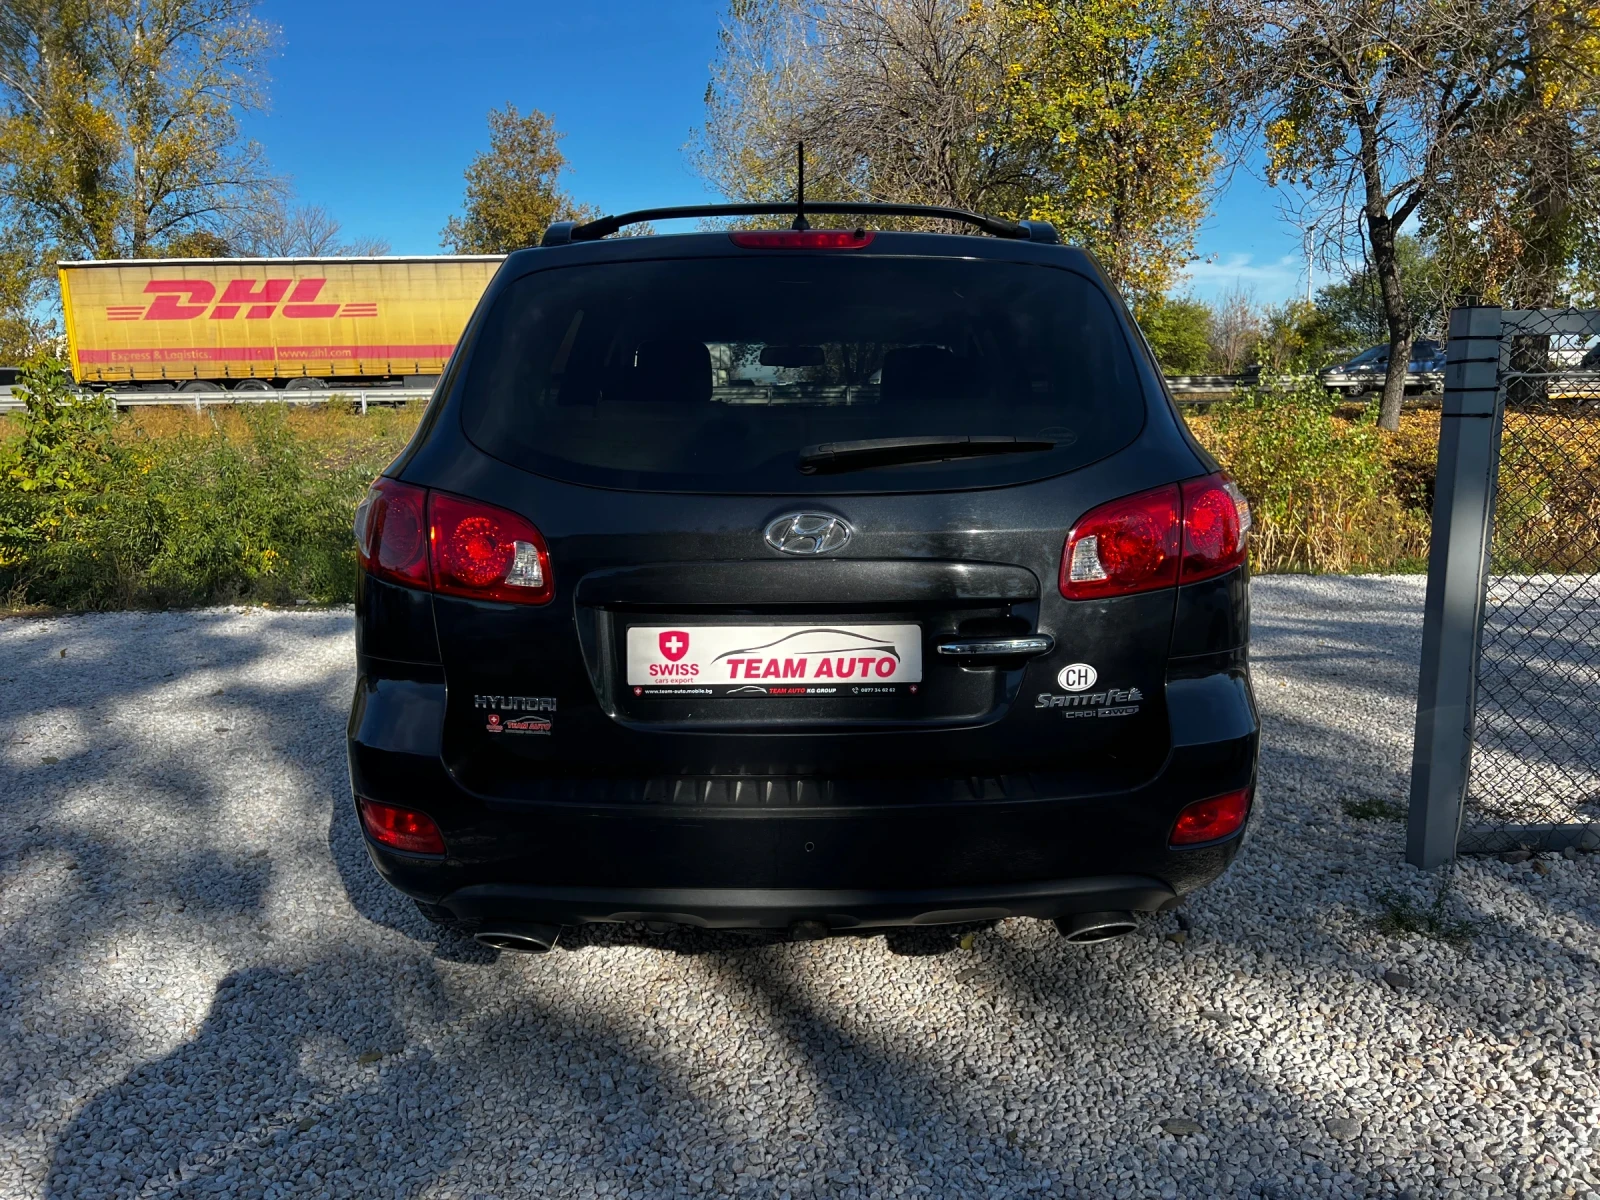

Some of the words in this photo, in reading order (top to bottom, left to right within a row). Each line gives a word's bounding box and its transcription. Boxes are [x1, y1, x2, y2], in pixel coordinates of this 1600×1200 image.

[143, 278, 341, 320] DHL
[111, 351, 151, 363] Express
[153, 351, 162, 360] &
[279, 347, 352, 358] www.dhl.com
[649, 663, 700, 676] SWISS
[726, 657, 808, 679] TEAM
[814, 657, 897, 678] AUTO
[670, 677, 694, 685] export
[1066, 668, 1088, 687] CH
[474, 694, 557, 711] HYUNDAI
